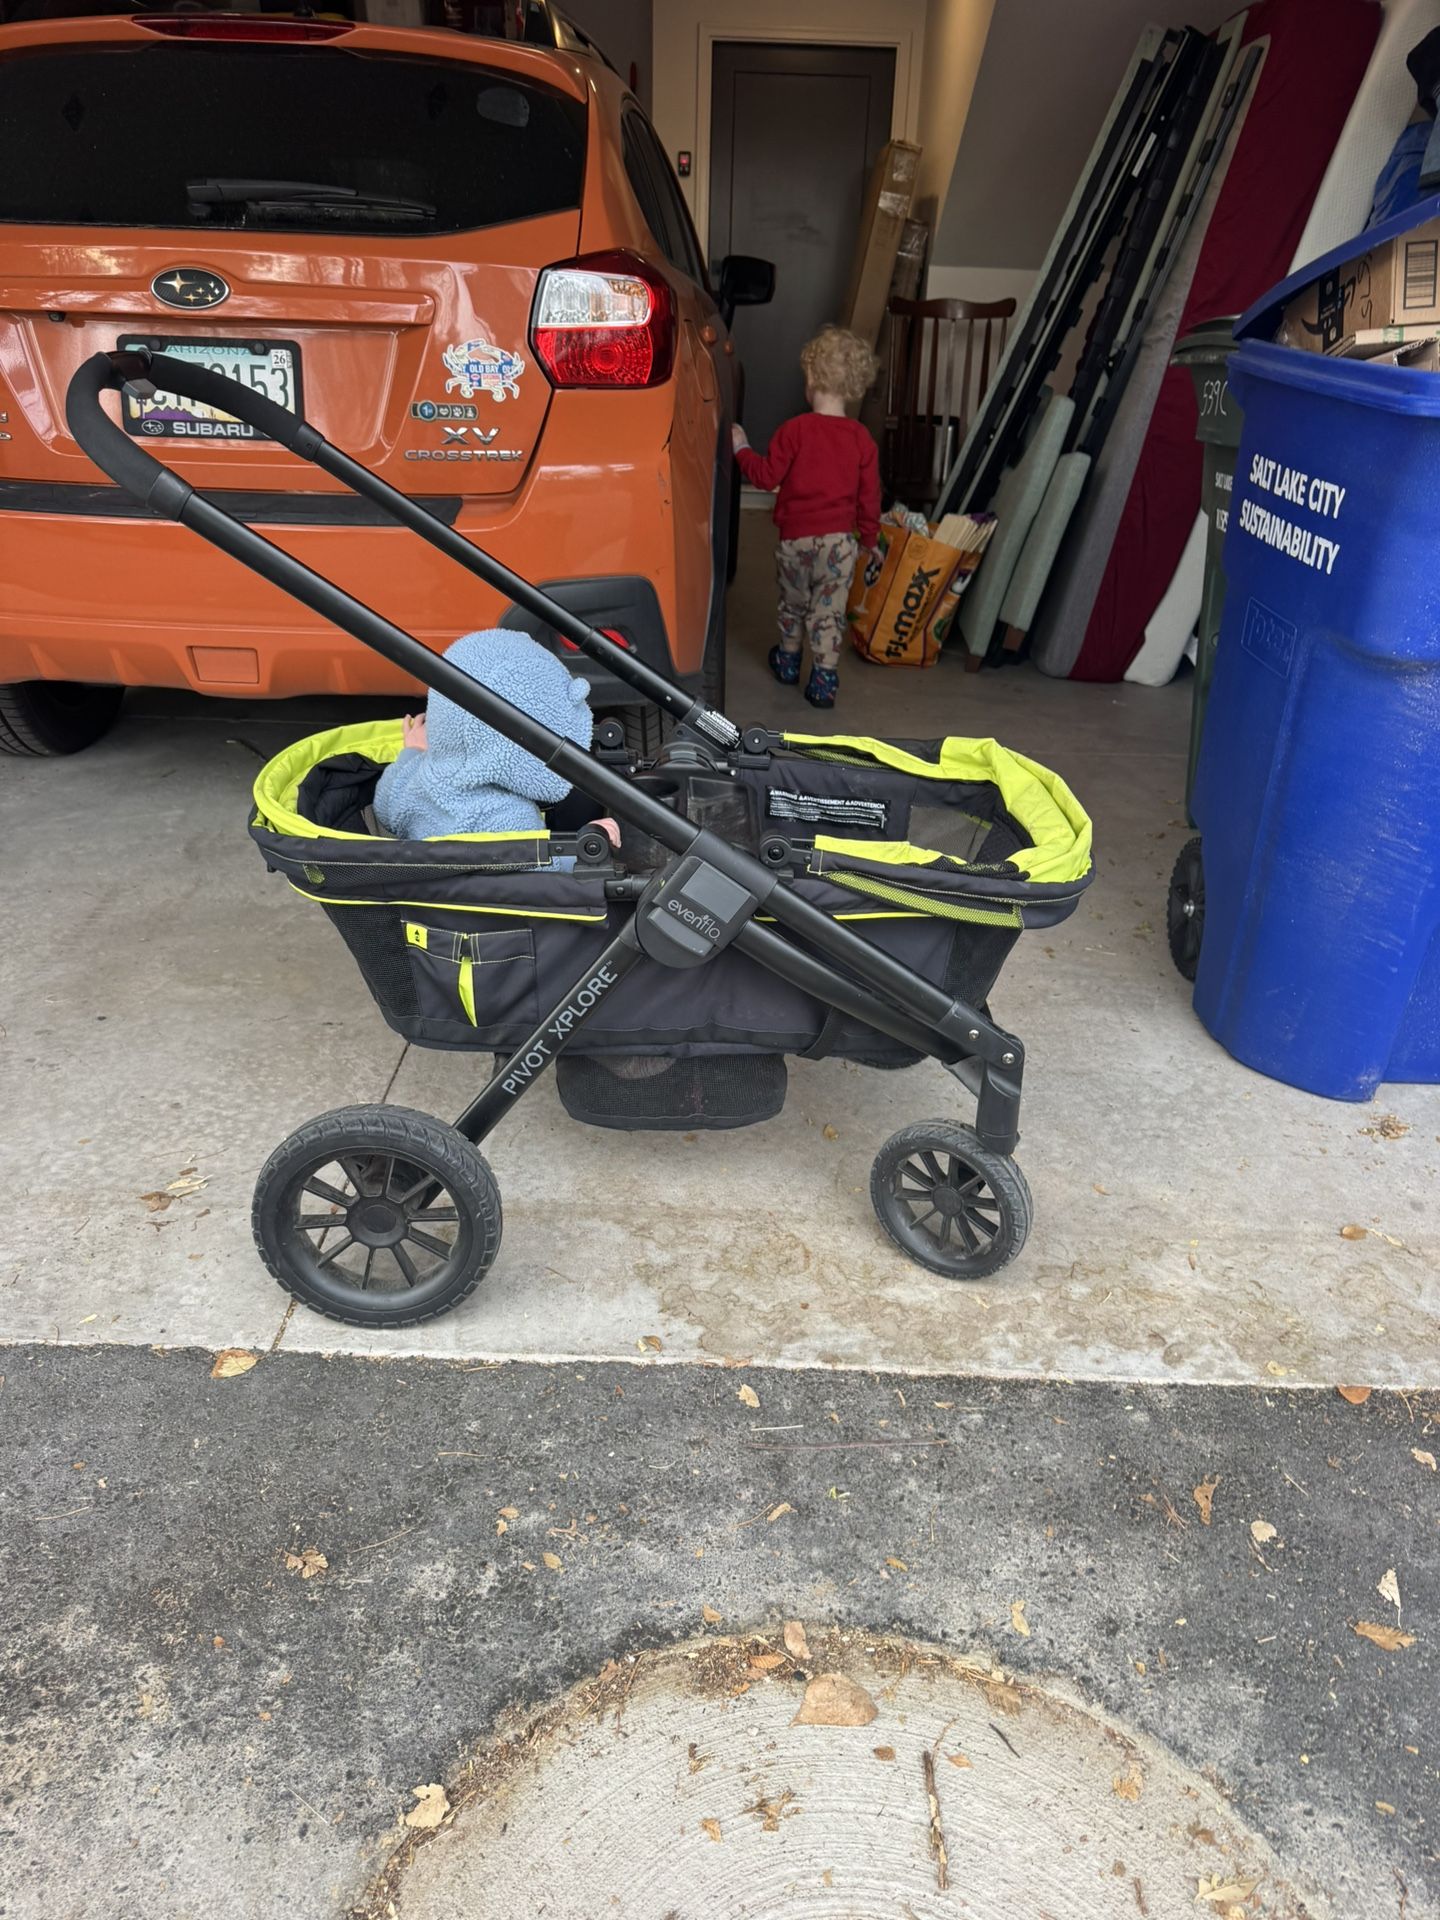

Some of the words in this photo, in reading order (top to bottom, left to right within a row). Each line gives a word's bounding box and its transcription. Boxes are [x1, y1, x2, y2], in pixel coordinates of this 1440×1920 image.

[167, 344, 251, 356] ARIZONA
[273, 354, 286, 365] 26
[469, 364, 484, 374] OLD
[485, 364, 499, 374] BAY
[173, 422, 254, 437] SUBARU
[441, 427, 499, 444] XV
[405, 450, 523, 461] CROSSTREK
[1249, 453, 1276, 491] SALT
[1273, 463, 1308, 506] LAKE
[1308, 477, 1346, 519] CITY
[1239, 498, 1341, 574] SUSTAINABILITY
[667, 899, 720, 940] evenflo
[502, 1039, 551, 1095] PIVOT
